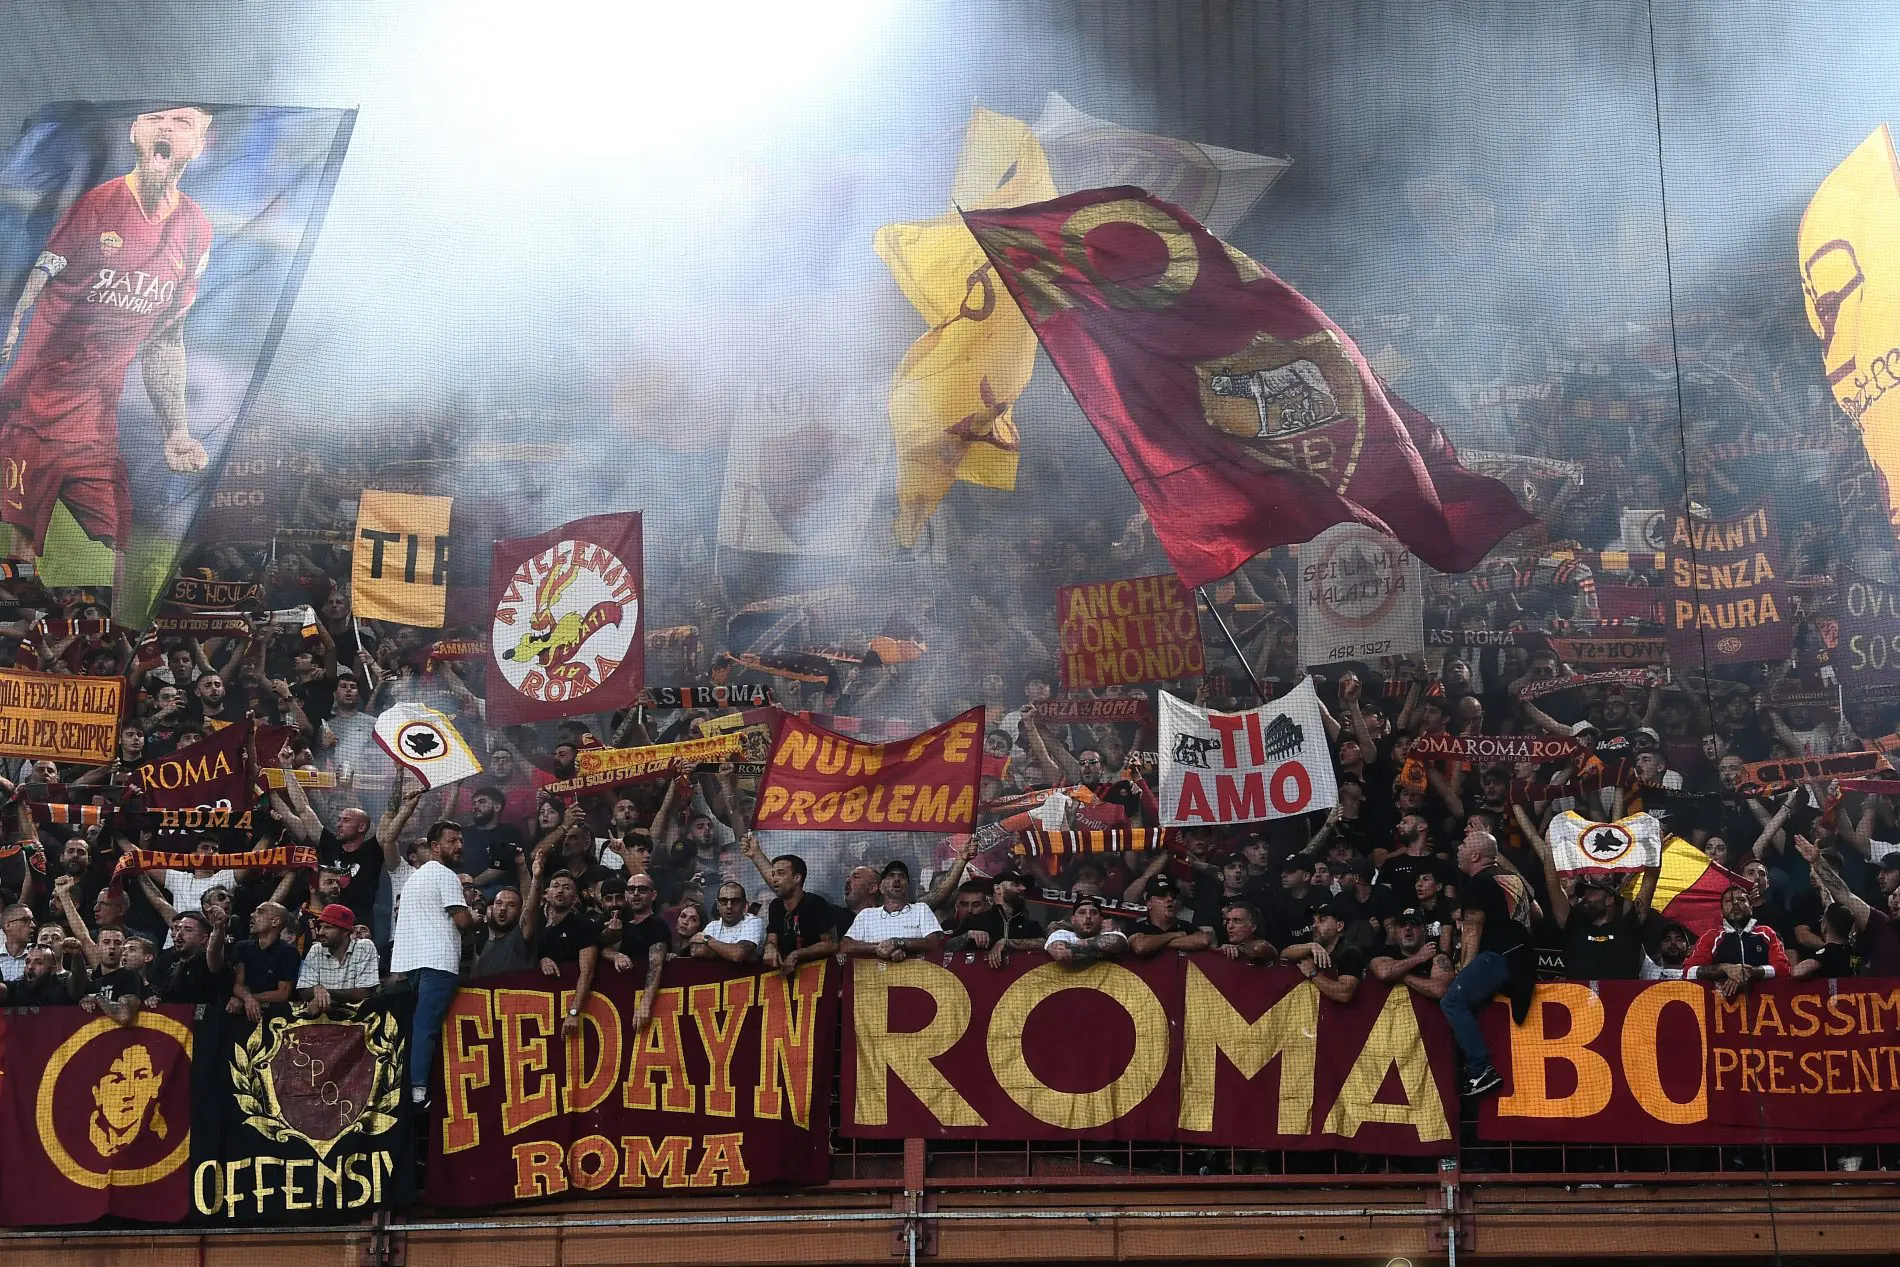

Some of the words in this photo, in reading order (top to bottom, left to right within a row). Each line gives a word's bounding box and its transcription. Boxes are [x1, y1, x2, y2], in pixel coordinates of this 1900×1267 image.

[1672, 507, 1768, 552] AVANTI
[495, 540, 637, 626] AVVELENATI
[1304, 561, 1337, 582] SEI
[1342, 556, 1369, 577] LA
[1373, 550, 1410, 571] MIA
[1673, 552, 1776, 590] SENZA
[1069, 575, 1184, 621] ANCHE
[1674, 593, 1780, 630] PAURA
[1060, 609, 1198, 655] CONTRO
[1328, 645, 1355, 660] ASR
[1360, 640, 1392, 656] 1927
[1430, 629, 1454, 644] AS
[1464, 630, 1516, 645] ROMA
[518, 655, 621, 703] ROMA
[1066, 655, 1093, 688] IL
[1095, 640, 1204, 685] MONDO
[81, 686, 116, 716] ALLA
[697, 684, 767, 703] ROMA
[1035, 702, 1079, 717] ORZA
[1091, 700, 1139, 716] ROMA
[31, 719, 61, 753] PER
[61, 721, 114, 757] SEMPRE
[773, 729, 884, 777] NUN
[1208, 712, 1266, 769] TI
[1416, 737, 1578, 758] OMAROMAROM
[139, 750, 234, 791] ROMA
[586, 769, 615, 787] SOLO
[616, 761, 646, 781] STAR
[738, 764, 766, 774] ROM
[757, 784, 974, 825] PROBLEMA
[1174, 760, 1313, 822] AMO
[212, 846, 287, 868] MERDA
[443, 959, 828, 1156] FEDAYN
[853, 957, 1452, 1143] ROMA
[1494, 980, 1708, 1125] BO
[1712, 1046, 1900, 1094] PRESENT
[292, 1042, 353, 1126] SPQR
[511, 1131, 750, 1199] ROMA
